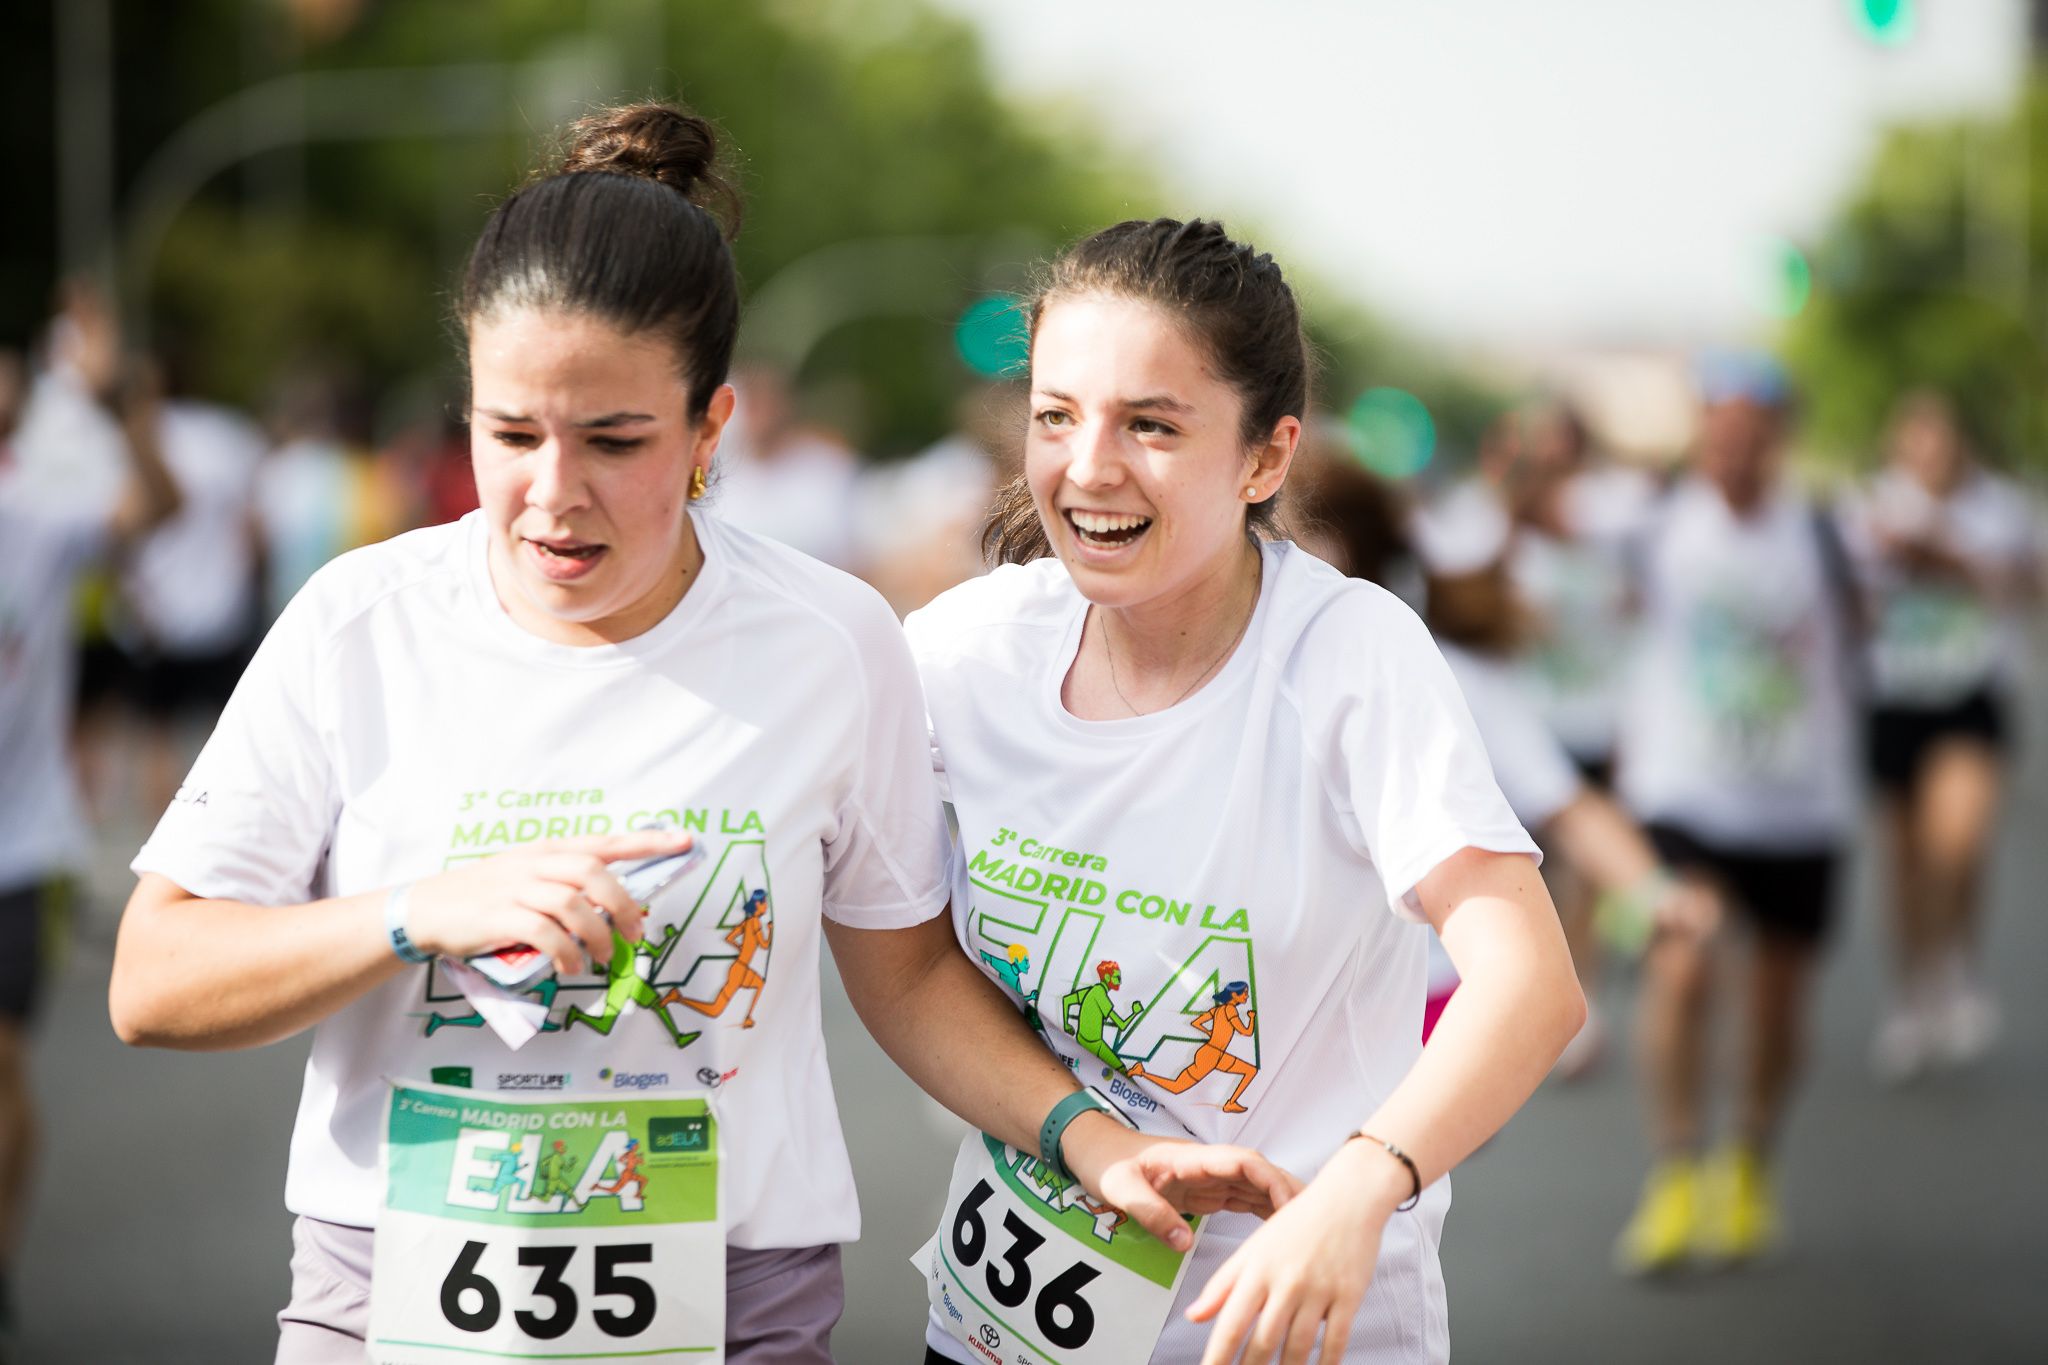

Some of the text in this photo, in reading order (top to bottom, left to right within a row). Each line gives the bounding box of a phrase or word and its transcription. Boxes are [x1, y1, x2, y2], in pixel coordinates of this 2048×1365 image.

[497, 787, 606, 810] Carrera
[451, 814, 612, 848] MADRID
[720, 809, 766, 834] LA
[1018, 837, 1108, 872] Carrera
[969, 849, 1250, 932] MADRID CON LA
[614, 1072, 668, 1090] Biogen
[1109, 1078, 1158, 1112] Biogen
[413, 1101, 458, 1119] Carrera
[460, 1107, 545, 1130] MADRID
[548, 1112, 597, 1129] CON
[600, 1111, 628, 1127] LA
[445, 1128, 645, 1214] ELA
[952, 1178, 1102, 1350] 636
[440, 1240, 657, 1340] 635
[943, 1292, 963, 1324] Biogen
